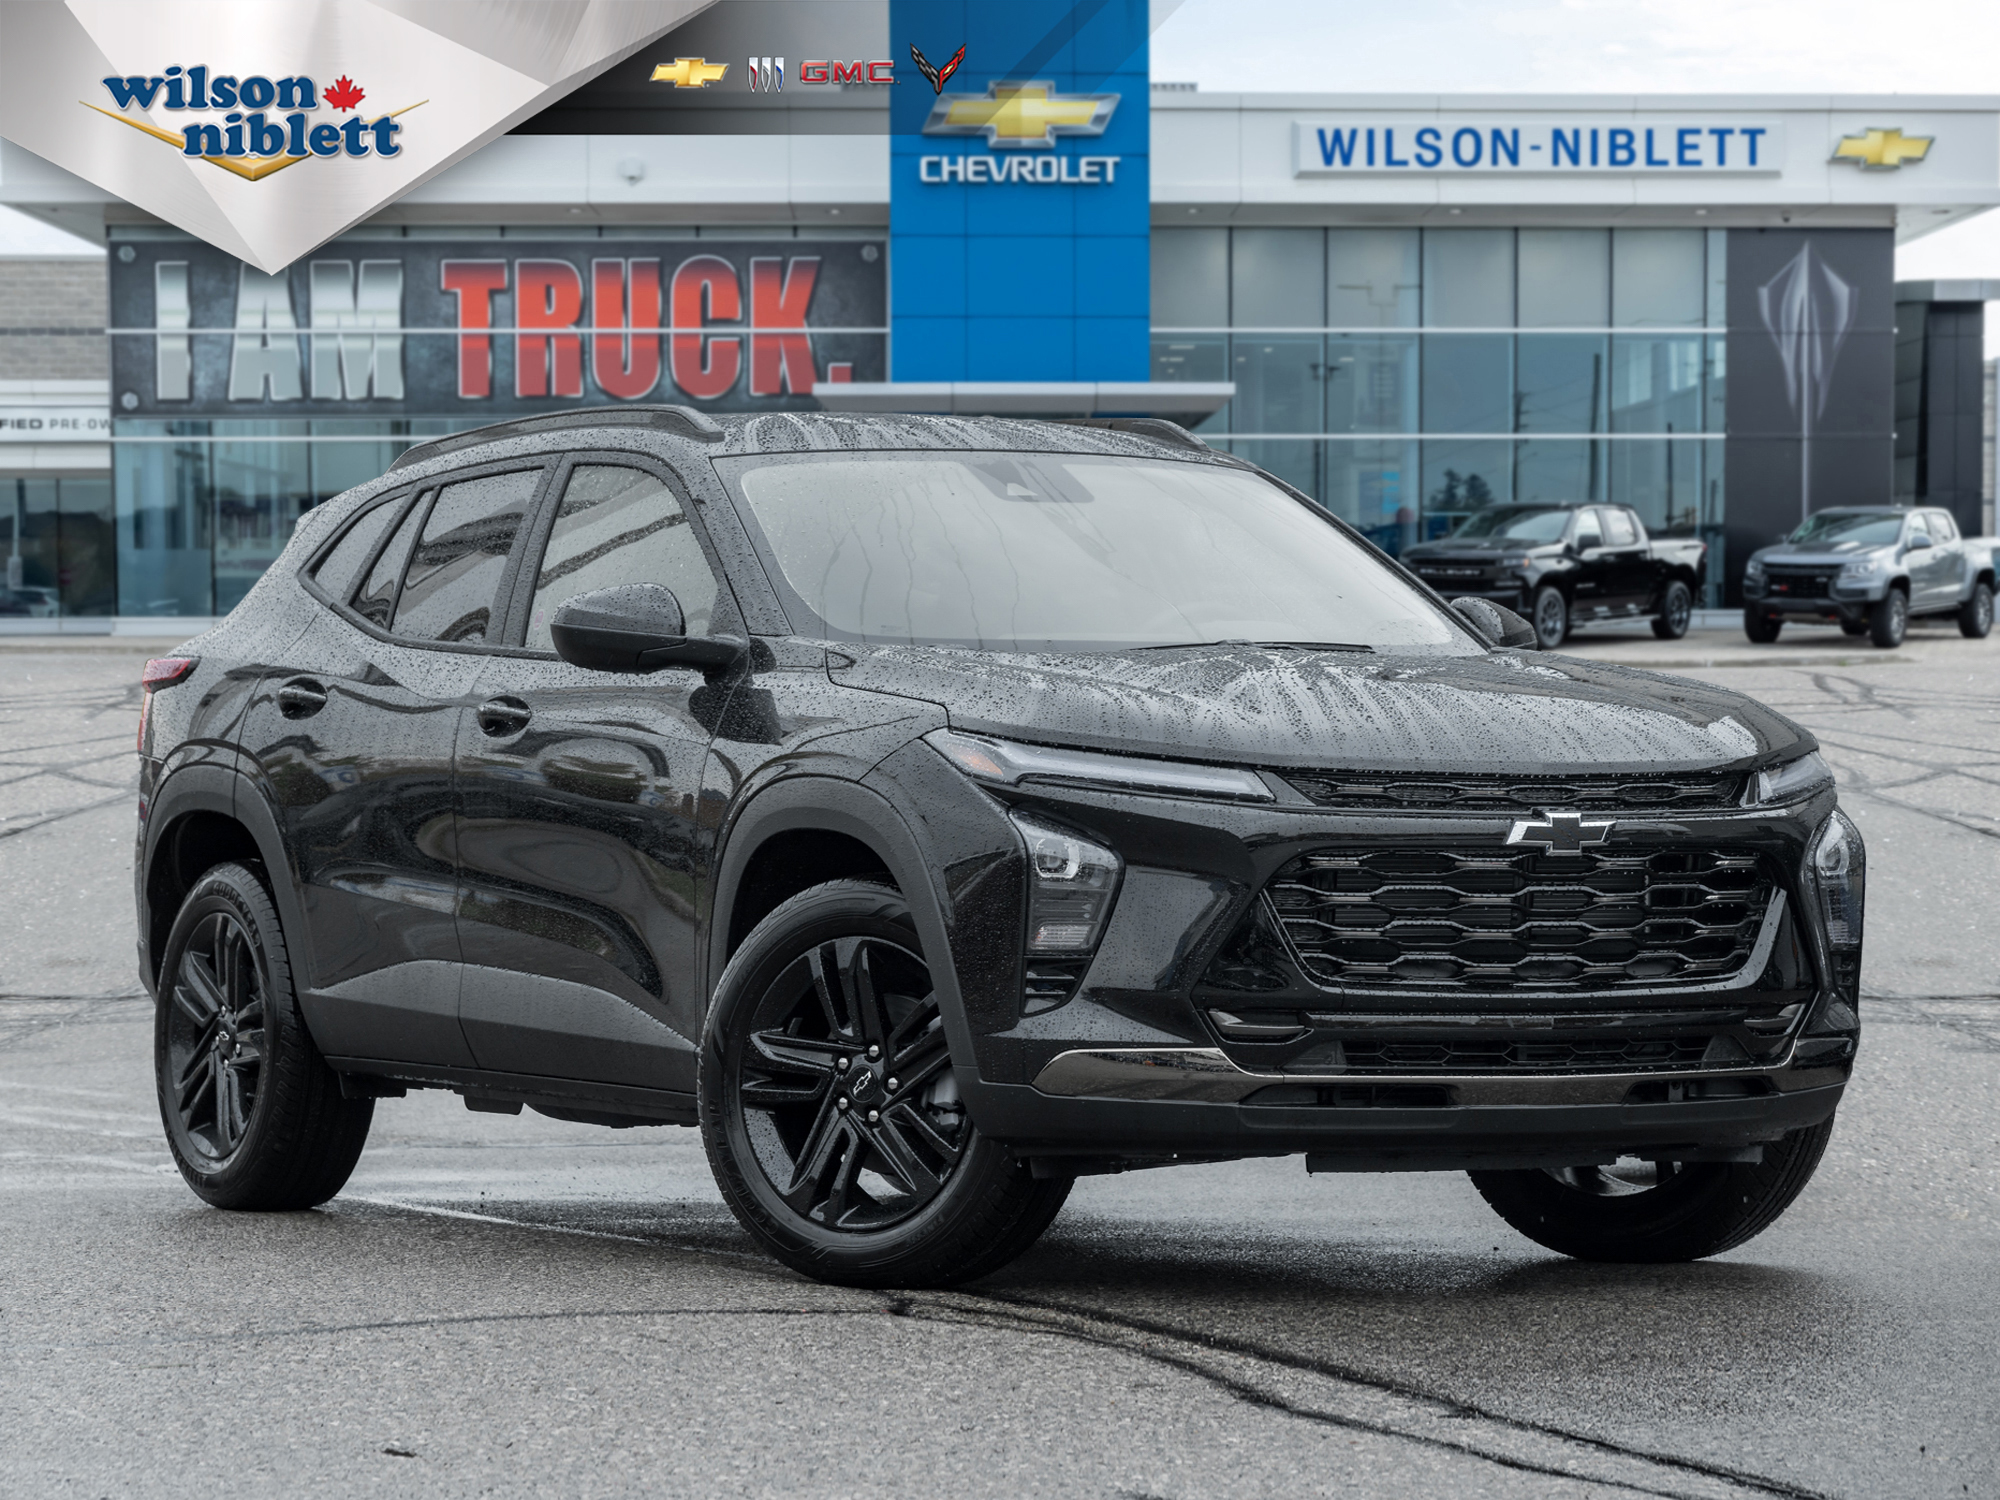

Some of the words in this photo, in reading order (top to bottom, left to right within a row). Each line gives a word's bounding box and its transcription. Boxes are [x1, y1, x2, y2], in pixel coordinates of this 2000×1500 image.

[1317, 127, 1767, 168] WILSON-NIBLETT
[920, 156, 1121, 183] CHEVROLET
[156, 261, 190, 400] I
[229, 259, 404, 400] AM
